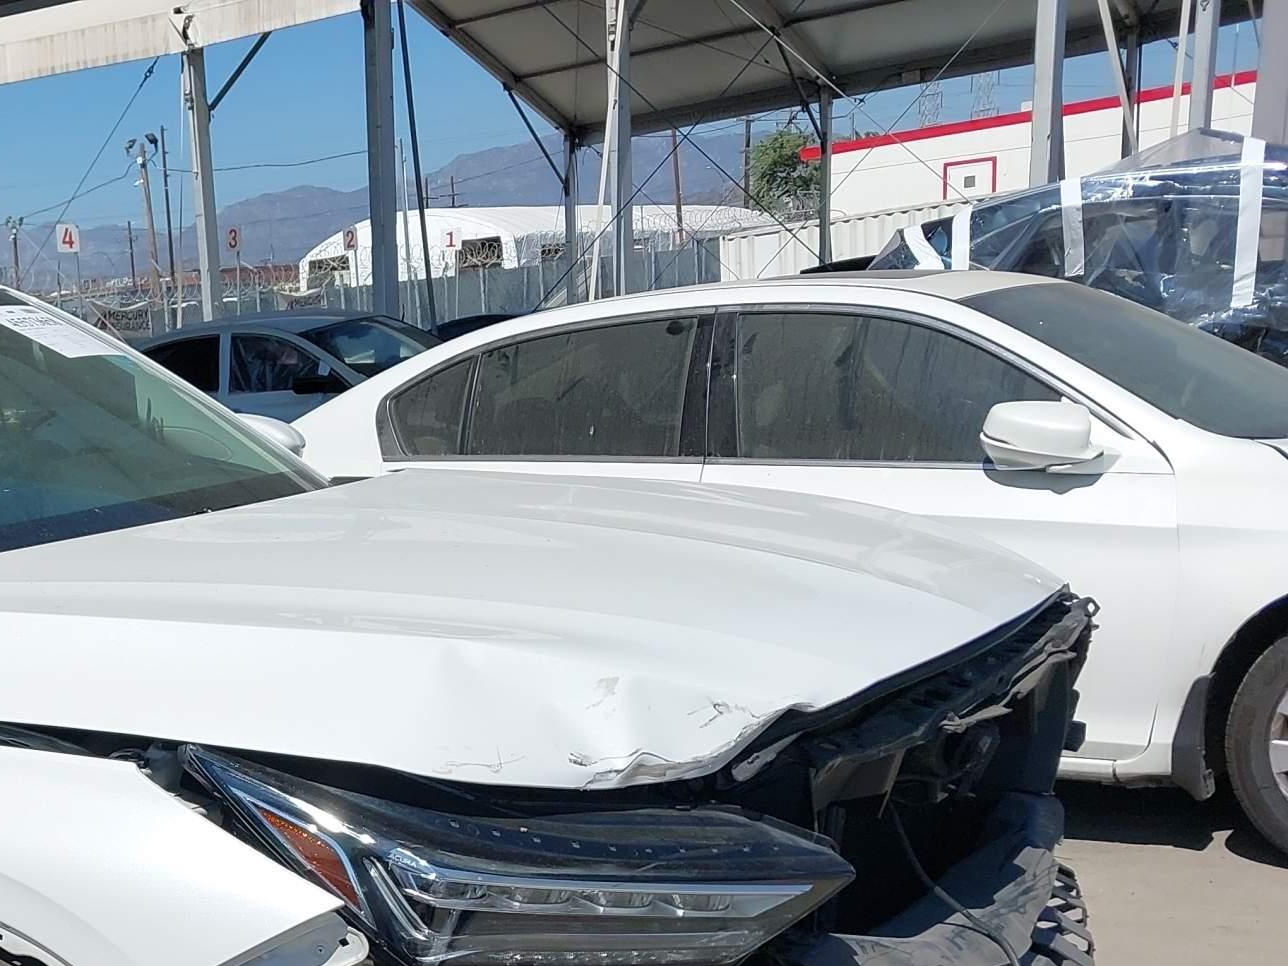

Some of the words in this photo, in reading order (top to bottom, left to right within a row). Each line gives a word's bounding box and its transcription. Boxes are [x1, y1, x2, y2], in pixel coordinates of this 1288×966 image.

[61, 227, 75, 249] 4
[228, 228, 238, 249] 3
[345, 230, 356, 249] 2
[445, 231, 456, 248] 1
[108, 309, 150, 321] MERCURY
[387, 852, 418, 869] ACURA
